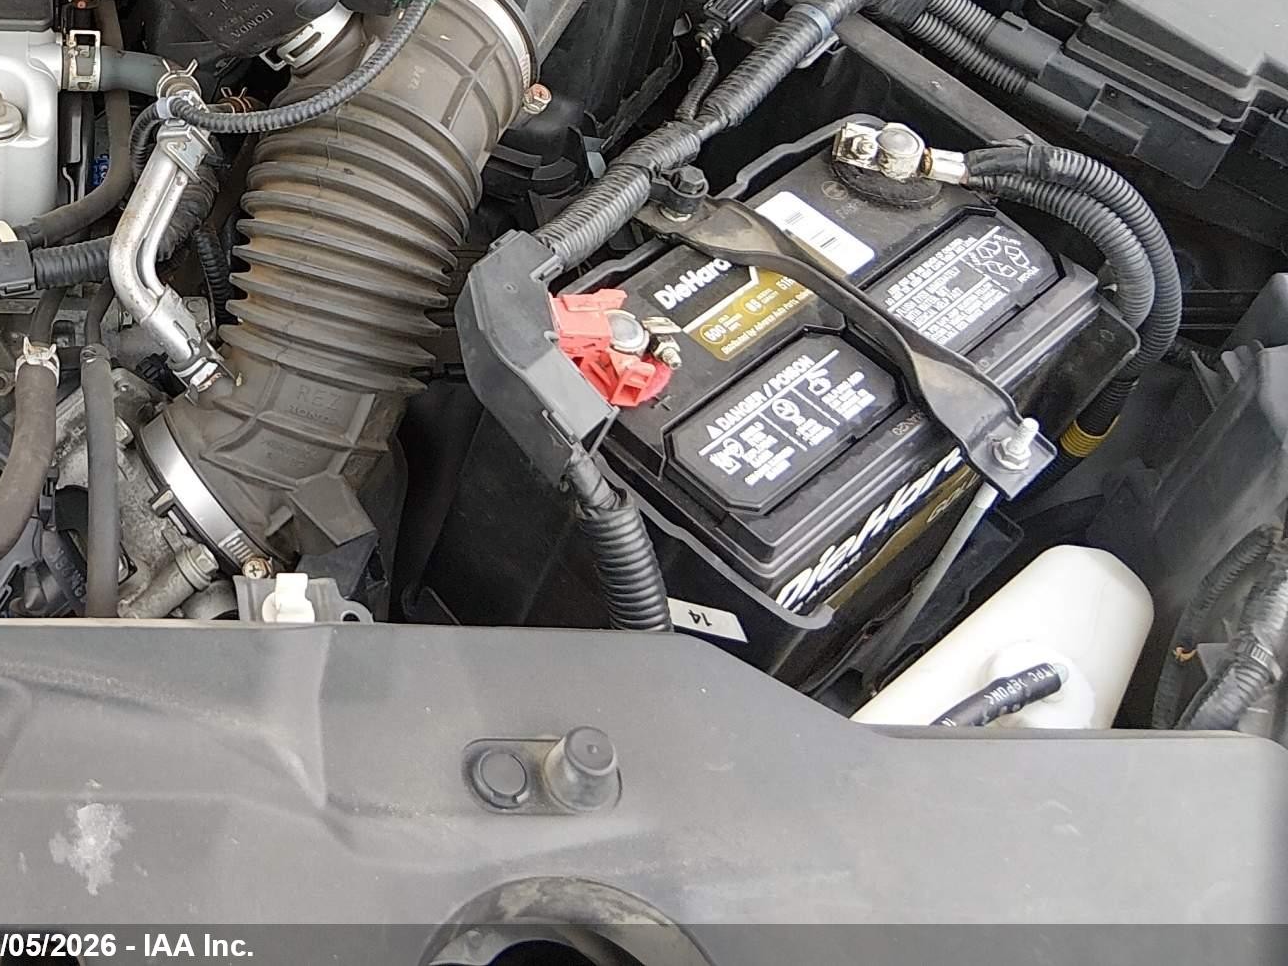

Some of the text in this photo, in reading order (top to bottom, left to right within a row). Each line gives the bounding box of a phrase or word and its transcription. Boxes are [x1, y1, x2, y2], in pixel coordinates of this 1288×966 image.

[714, 391, 768, 431] DANGER
[771, 354, 816, 390] POISON
[776, 445, 963, 609] DieHar
[687, 608, 713, 627] 14
